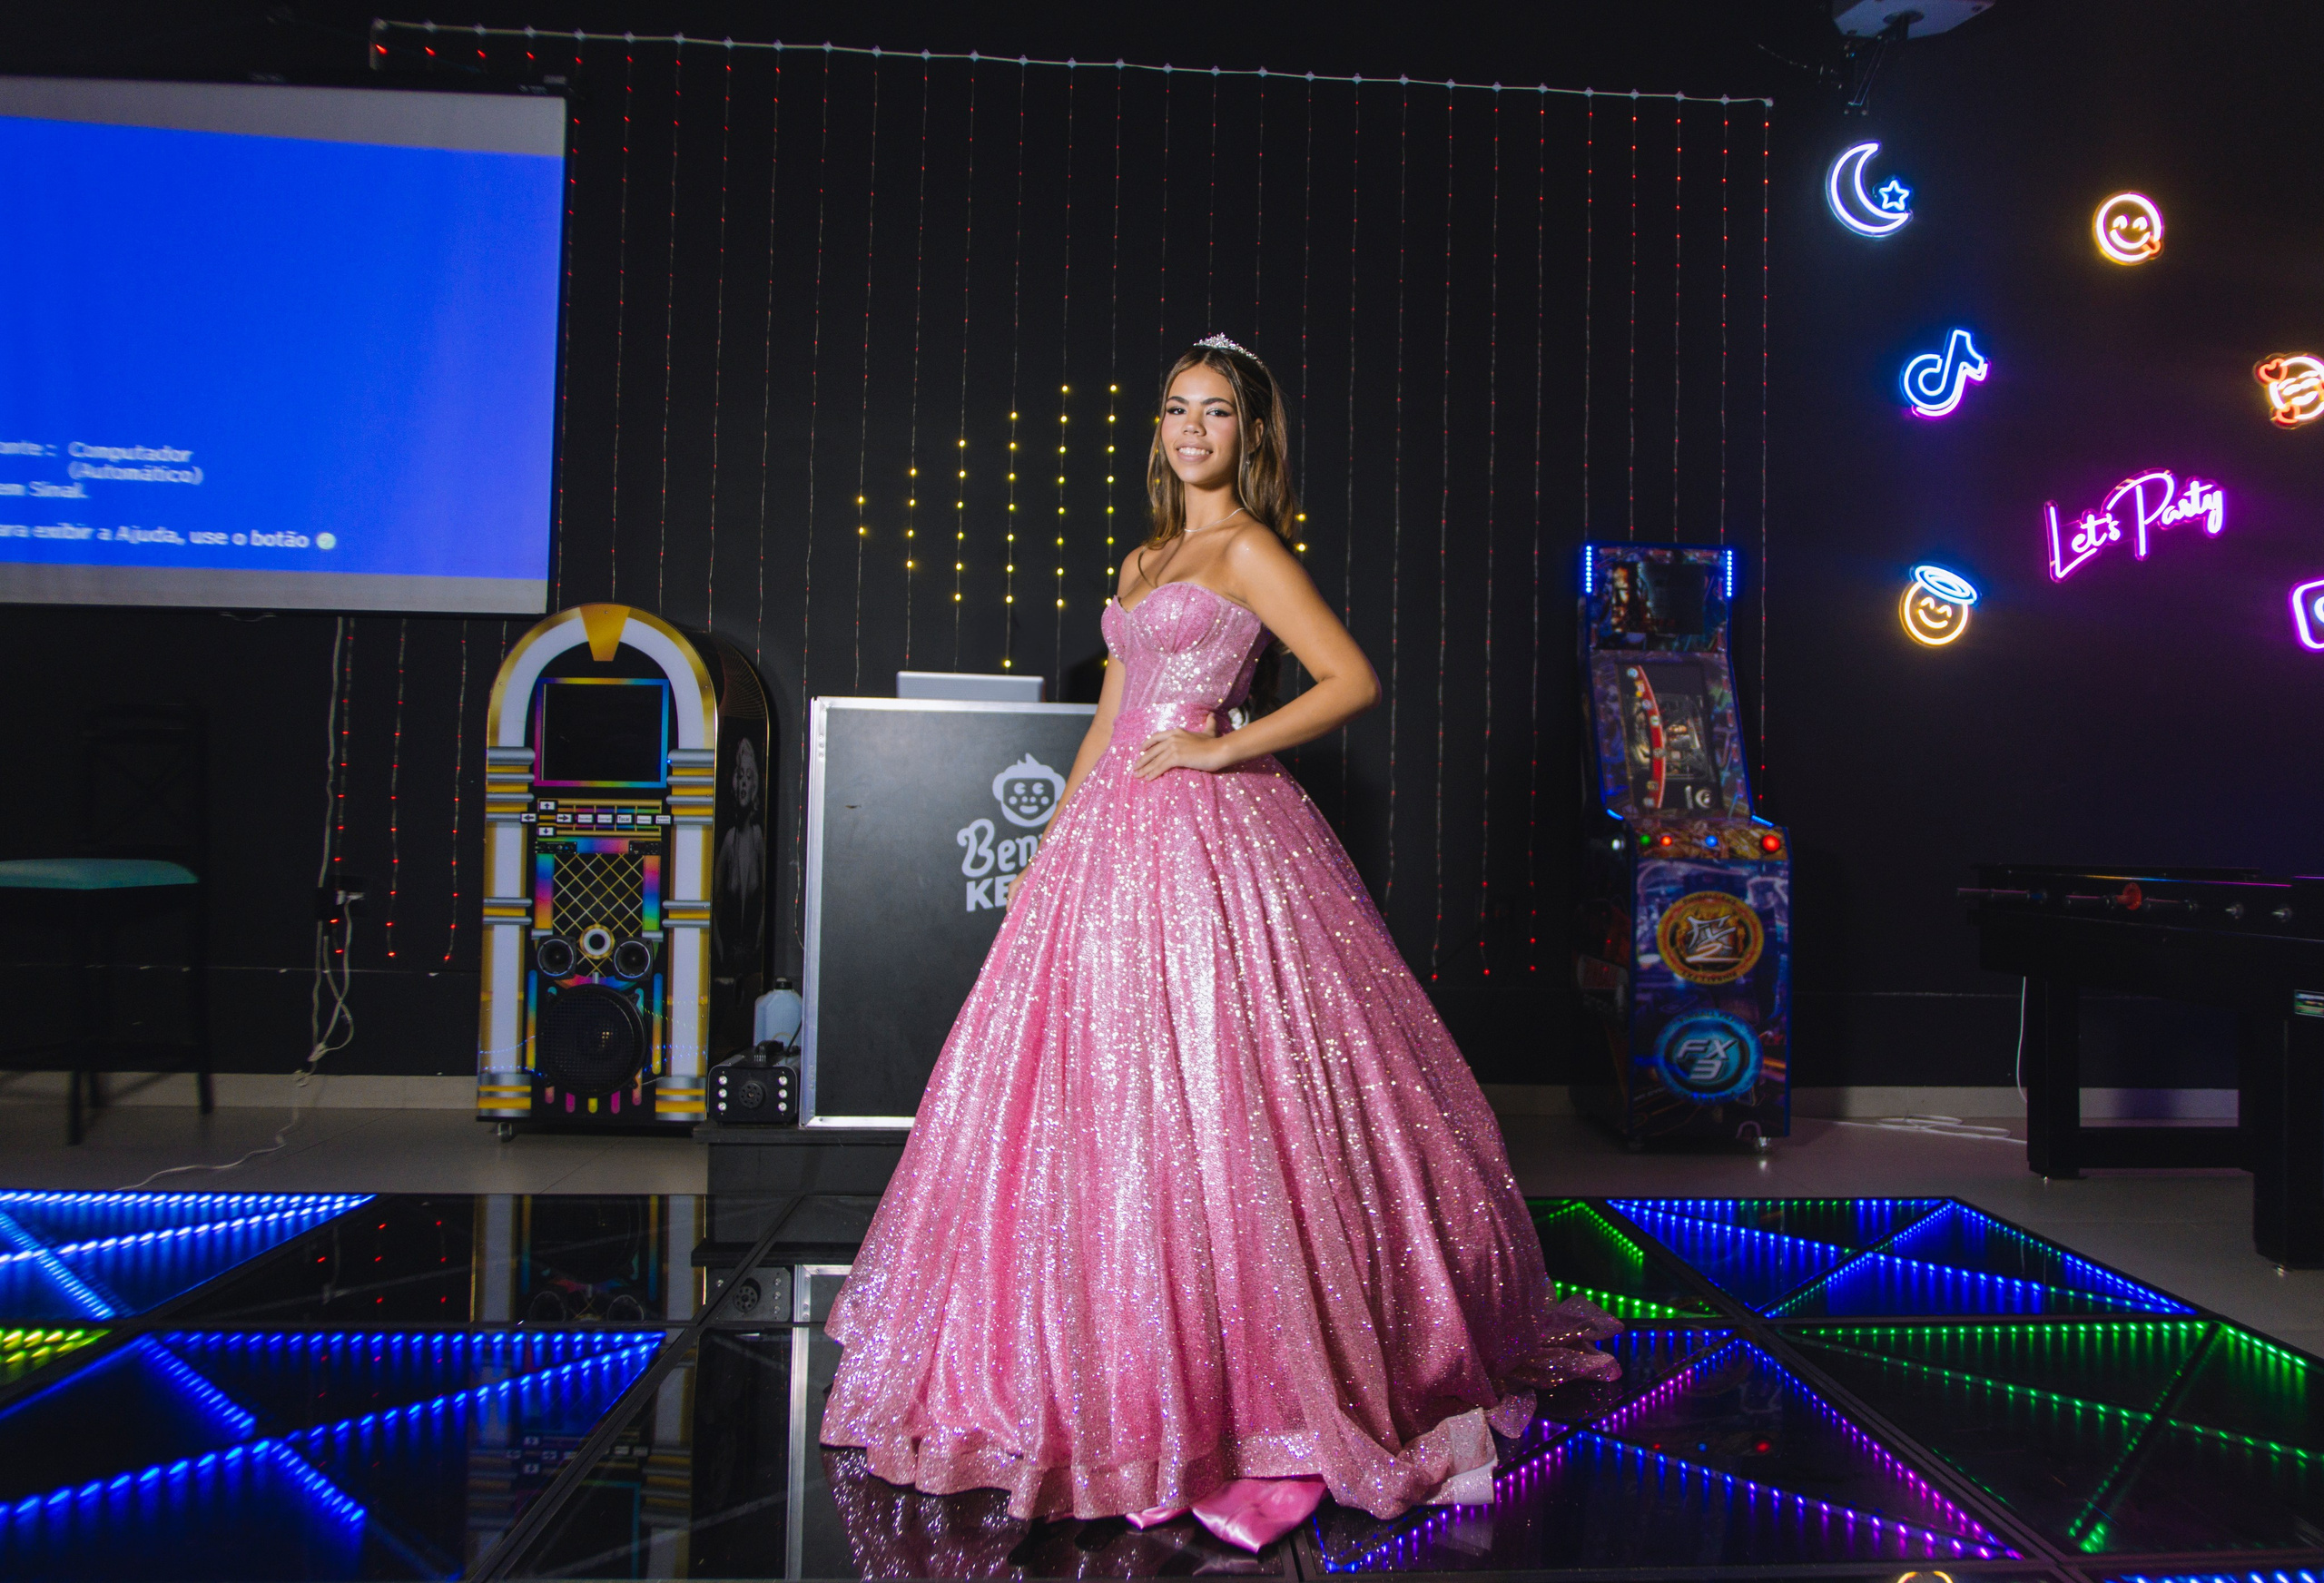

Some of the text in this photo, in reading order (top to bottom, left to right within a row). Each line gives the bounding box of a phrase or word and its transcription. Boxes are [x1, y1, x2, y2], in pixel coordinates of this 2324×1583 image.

[2048, 471, 2224, 579] Let's Party
[97, 527, 112, 541] a
[116, 526, 186, 545] Ajuda,
[189, 530, 229, 546] use
[231, 532, 247, 546] o
[250, 529, 310, 548] botão
[1677, 1038, 1738, 1060] FX
[1689, 1059, 1723, 1080] 3
